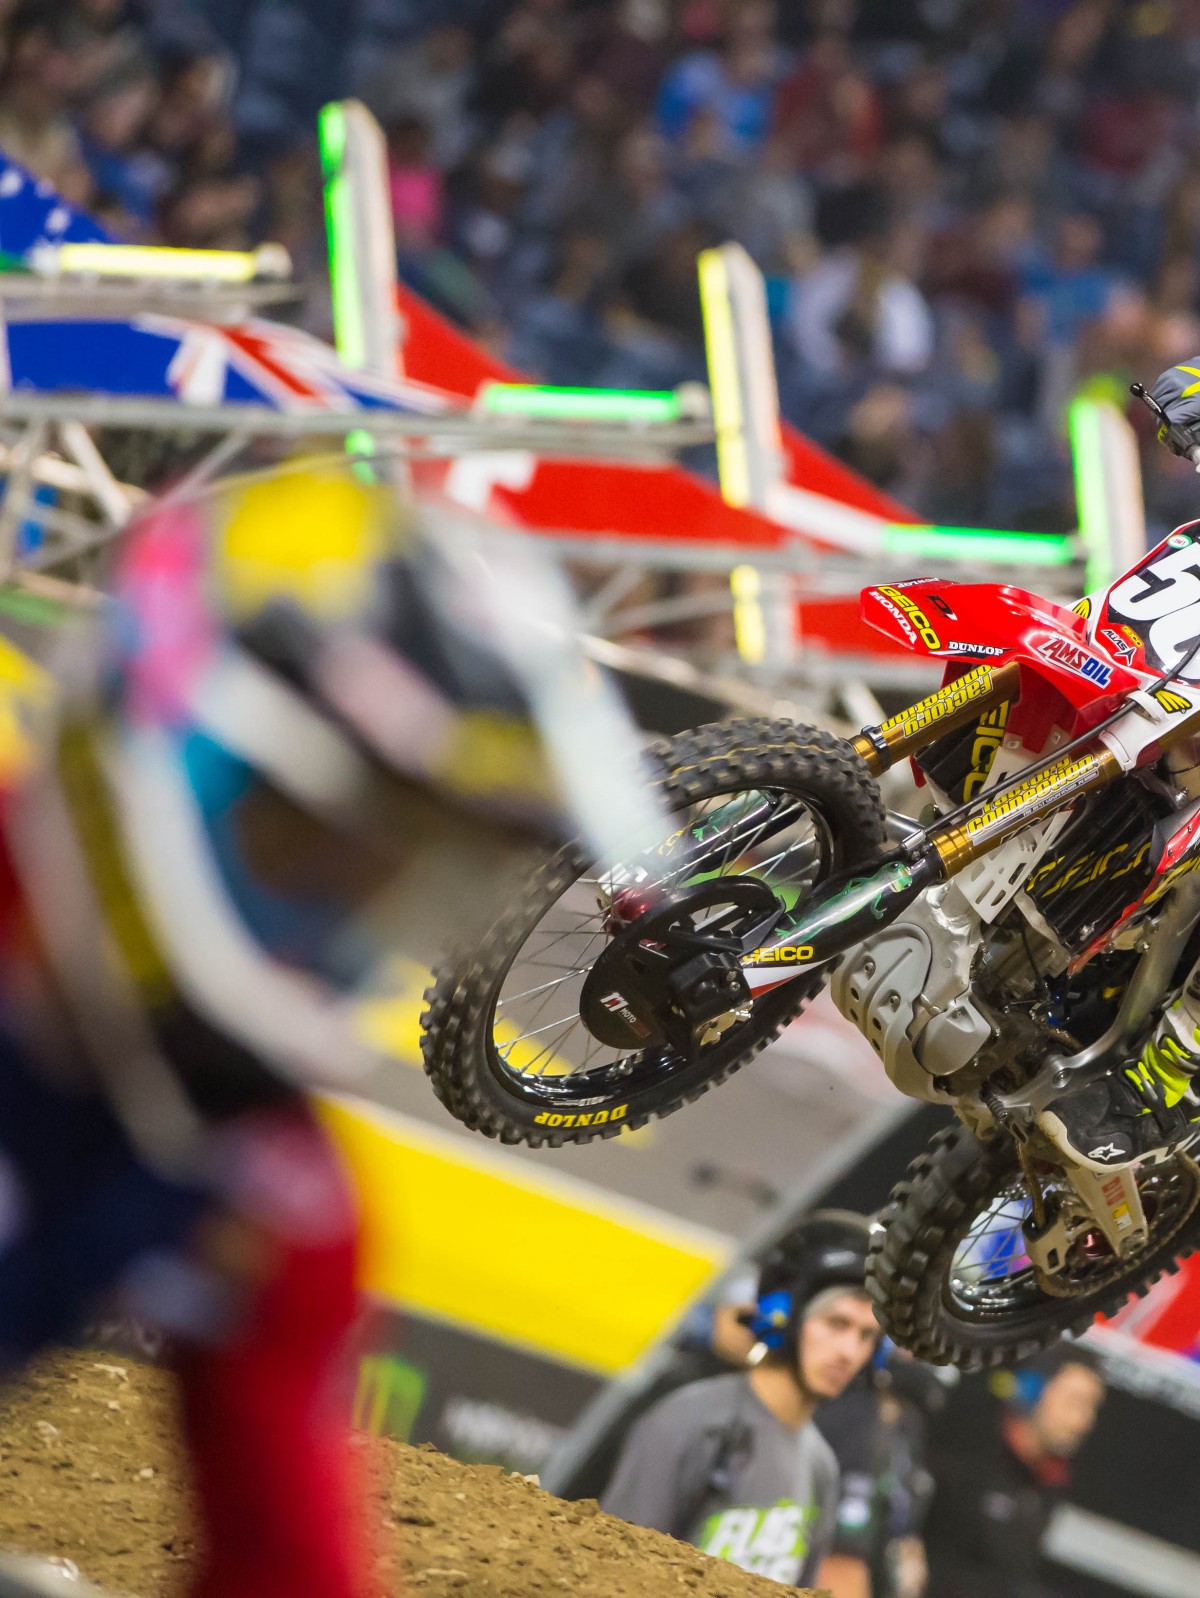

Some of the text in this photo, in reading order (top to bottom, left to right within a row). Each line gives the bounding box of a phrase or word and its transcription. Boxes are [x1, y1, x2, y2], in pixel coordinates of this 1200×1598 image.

[868, 590, 918, 645] HONDA
[877, 586, 942, 651] GEICO
[948, 641, 1004, 656] DUNLOP
[1038, 637, 1114, 688] AMSOIL
[904, 673, 994, 737] Factory
[967, 754, 1094, 834] Connection
[742, 945, 814, 963] GEICO
[534, 1103, 629, 1127] DUNLOP
